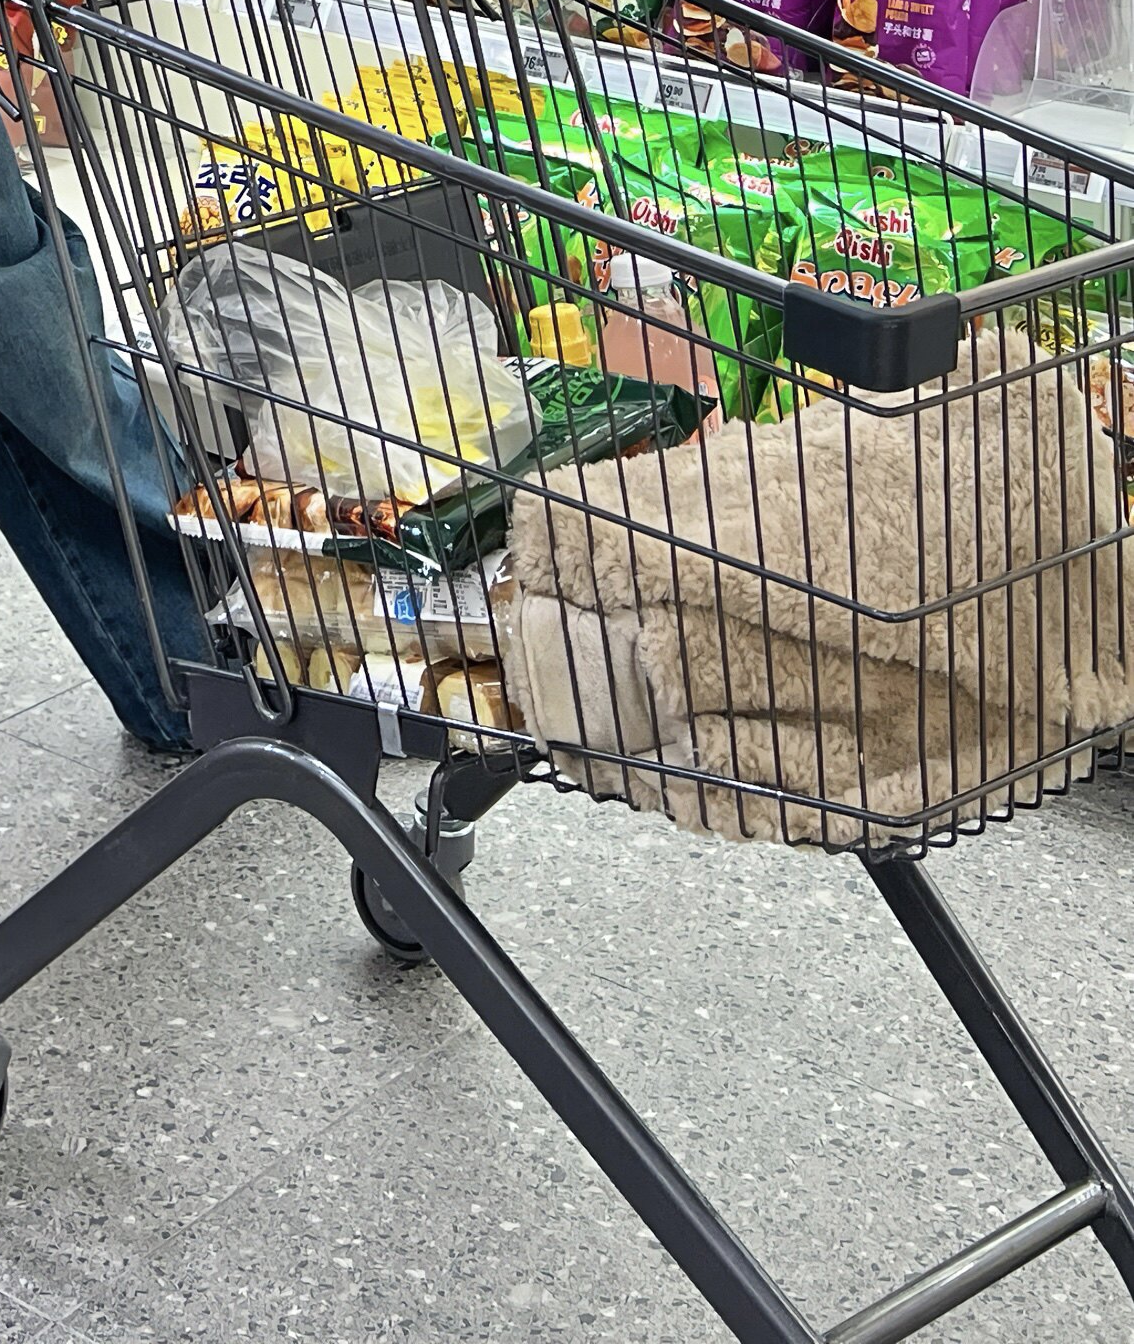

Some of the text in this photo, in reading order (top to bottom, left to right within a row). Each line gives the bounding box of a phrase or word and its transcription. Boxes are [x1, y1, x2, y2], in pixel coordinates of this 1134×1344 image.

[883, 22, 934, 42] 芋头和甘薯
[631, 197, 678, 234] Oishi
[835, 227, 894, 265] Oishi
[790, 262, 923, 307] Snack
